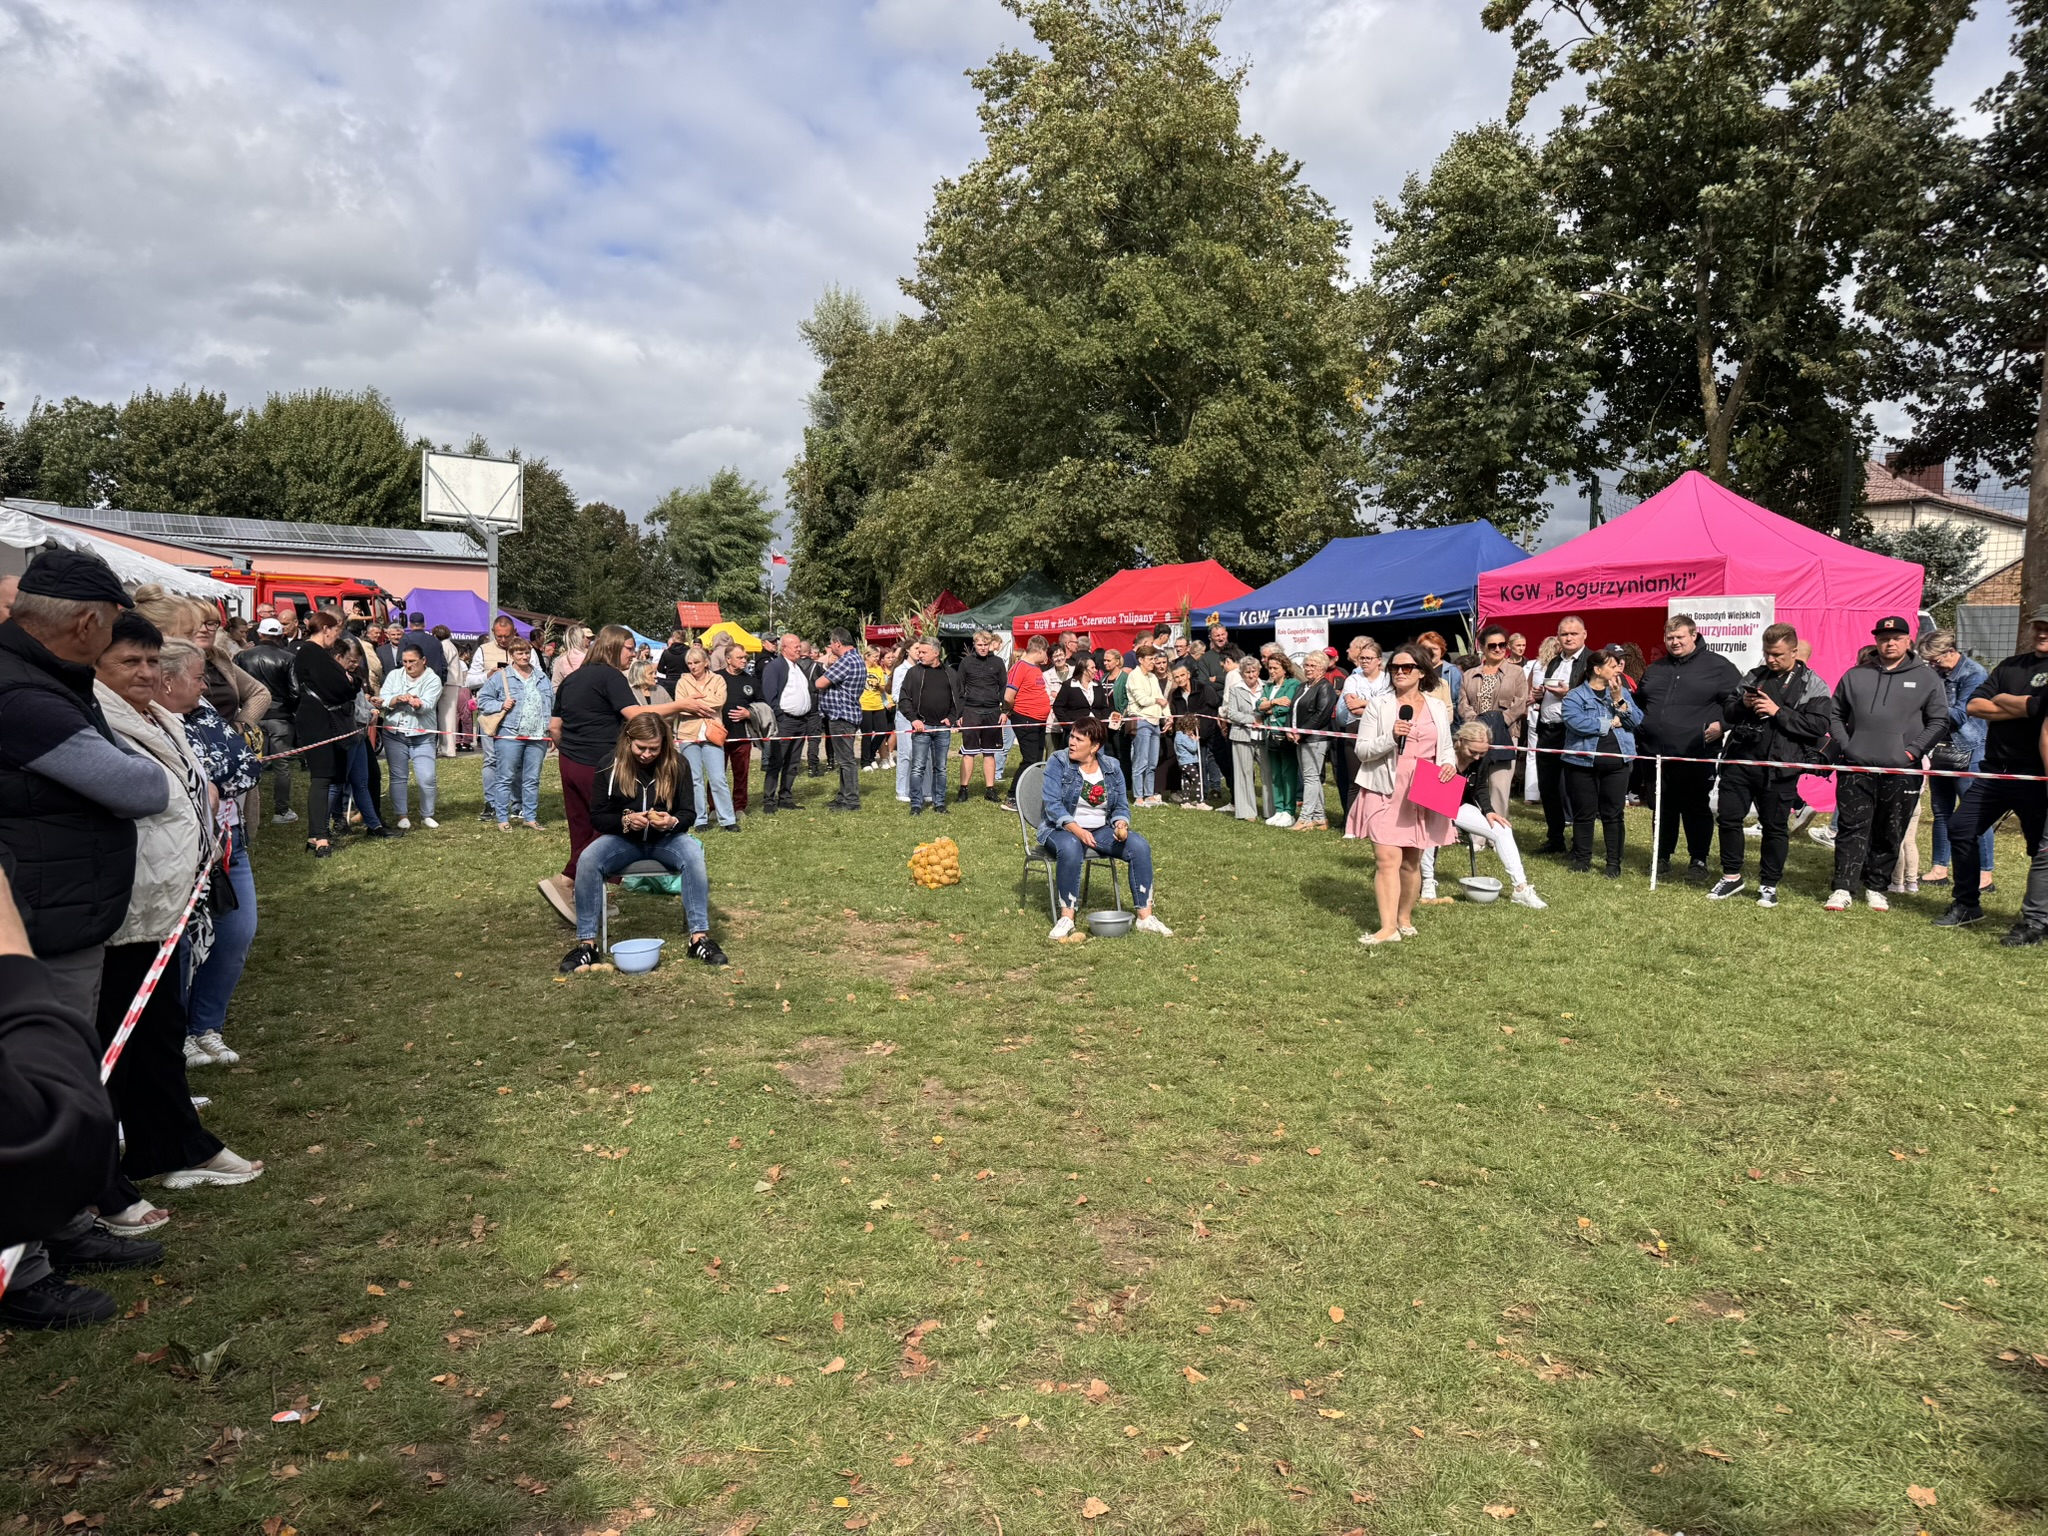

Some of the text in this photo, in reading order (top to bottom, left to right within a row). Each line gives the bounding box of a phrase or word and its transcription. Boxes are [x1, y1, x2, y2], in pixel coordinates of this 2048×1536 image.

[1500, 583, 1541, 602] KGW
[1239, 609, 1271, 626] KGW
[1727, 610, 1761, 621] Wiejskich
[1034, 619, 1050, 629] KGW
[1705, 641, 1747, 653] ogurzynie
